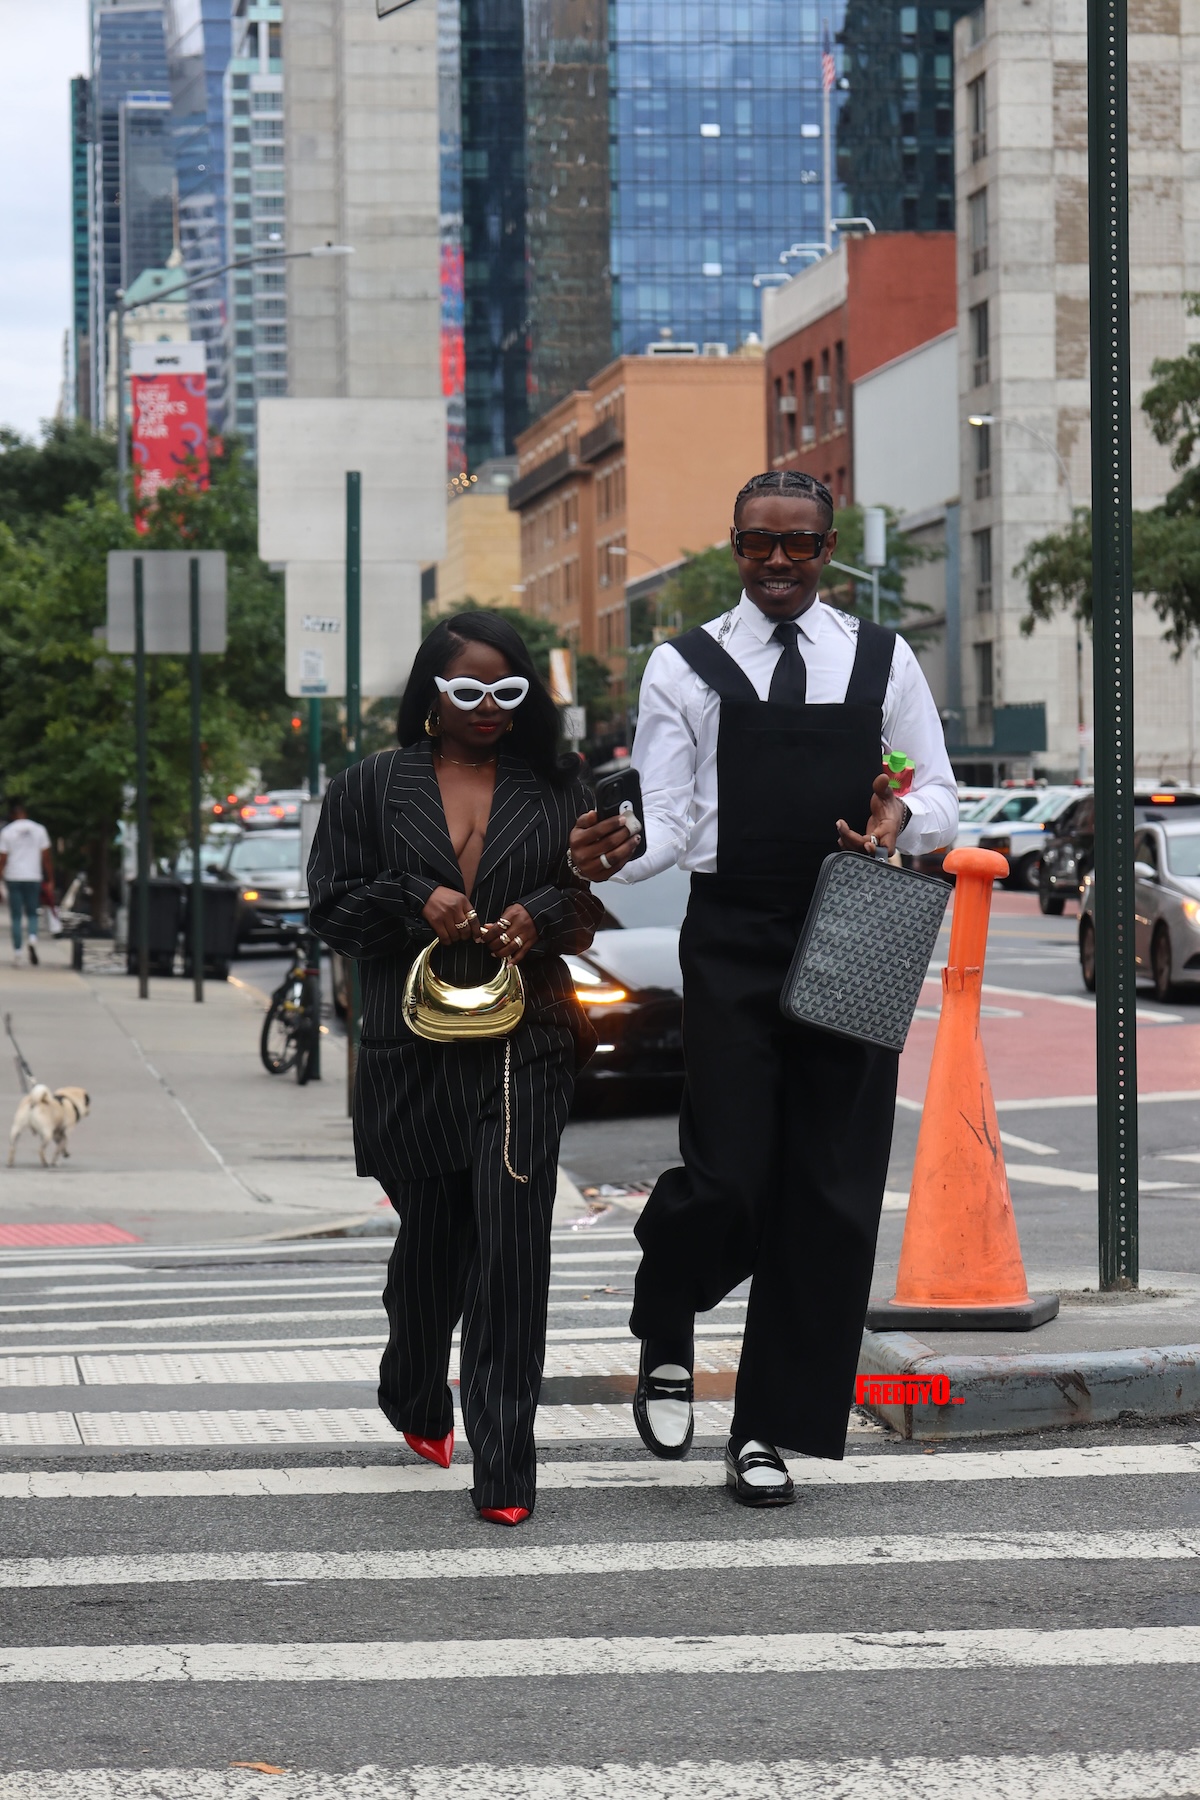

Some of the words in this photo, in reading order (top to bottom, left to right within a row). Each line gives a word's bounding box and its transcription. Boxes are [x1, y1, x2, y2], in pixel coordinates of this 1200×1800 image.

[137, 390, 169, 402] NEW
[138, 401, 188, 415] YORK'S
[138, 414, 165, 425] ART
[138, 425, 169, 438] FAIR
